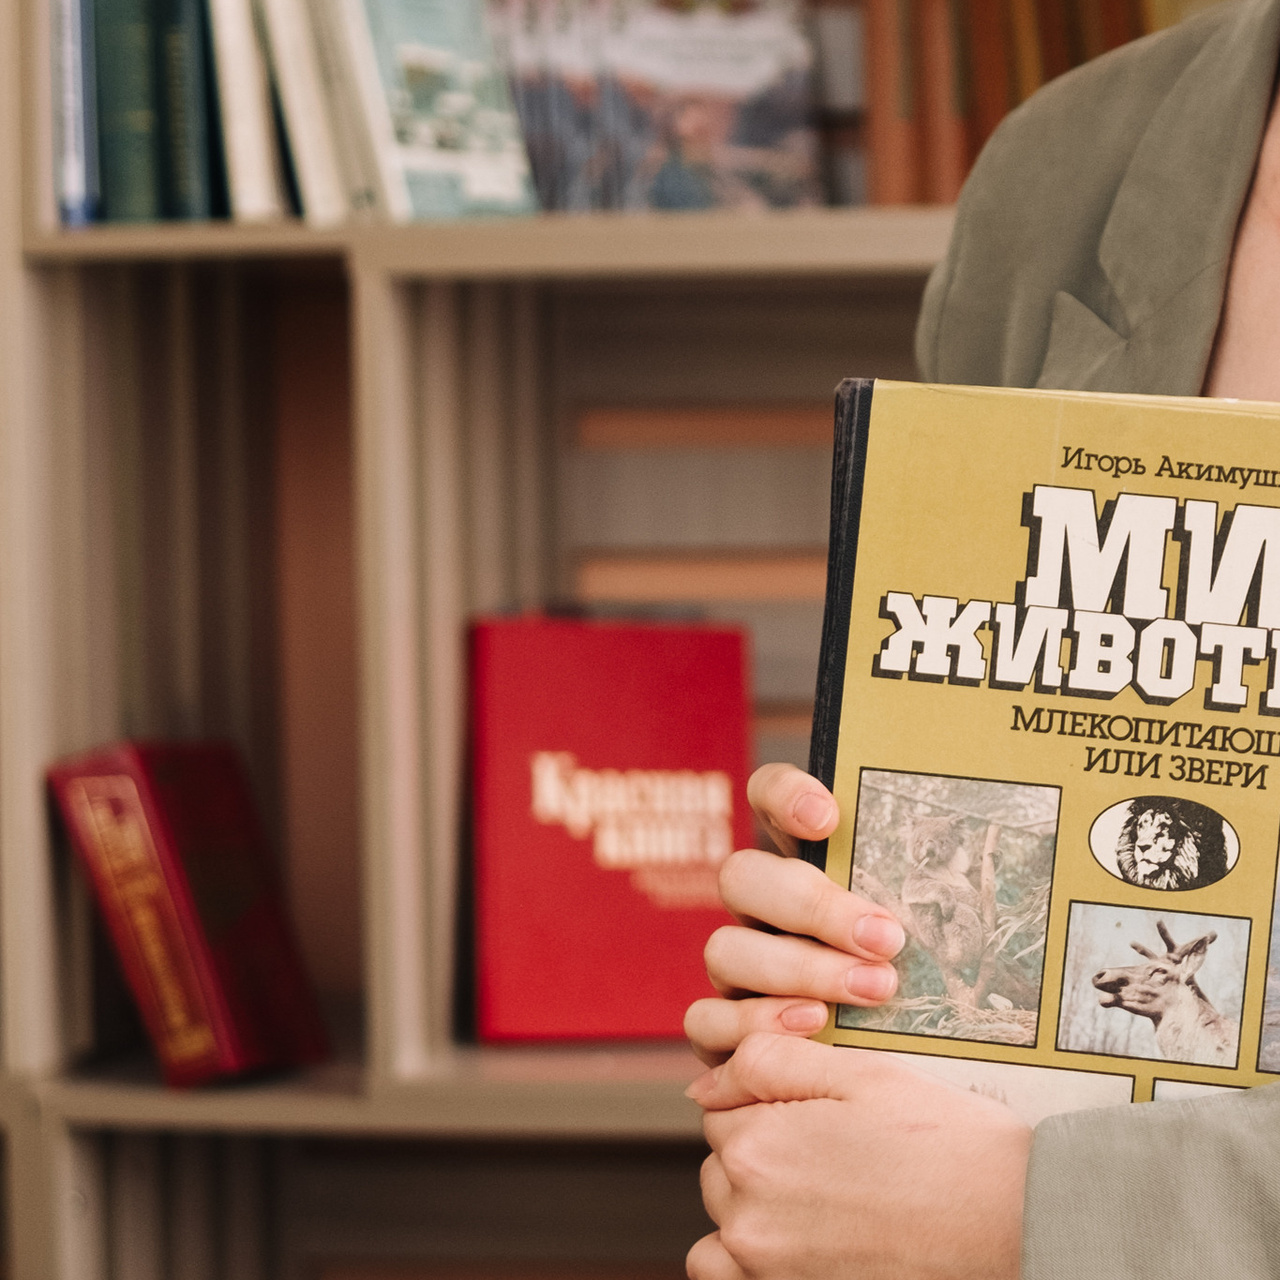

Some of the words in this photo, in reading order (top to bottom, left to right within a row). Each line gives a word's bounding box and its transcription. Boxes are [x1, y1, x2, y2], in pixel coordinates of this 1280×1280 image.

[1060, 446, 1147, 478] Игорь
[1083, 746, 1163, 779] ИЛИ
[1168, 755, 1270, 790] ЗВЕРИ
